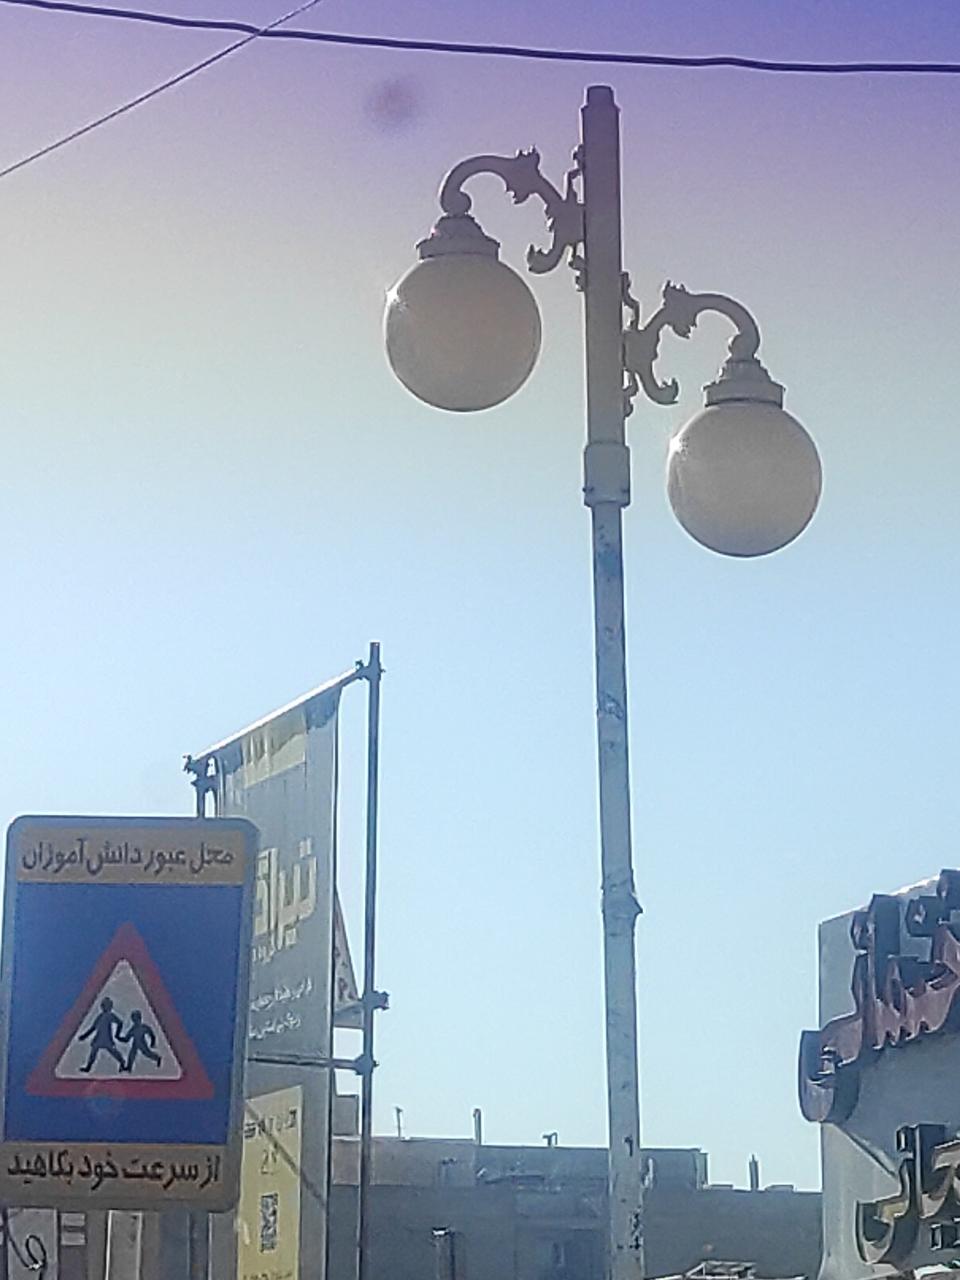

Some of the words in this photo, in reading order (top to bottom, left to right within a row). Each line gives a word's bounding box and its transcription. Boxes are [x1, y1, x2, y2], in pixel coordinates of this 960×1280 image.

[143, 849, 187, 877] عبور
[189, 843, 235, 874] محل
[79, 1151, 119, 1191] خود
[122, 1157, 199, 1191] سرعت
[199, 1154, 221, 1190] از
